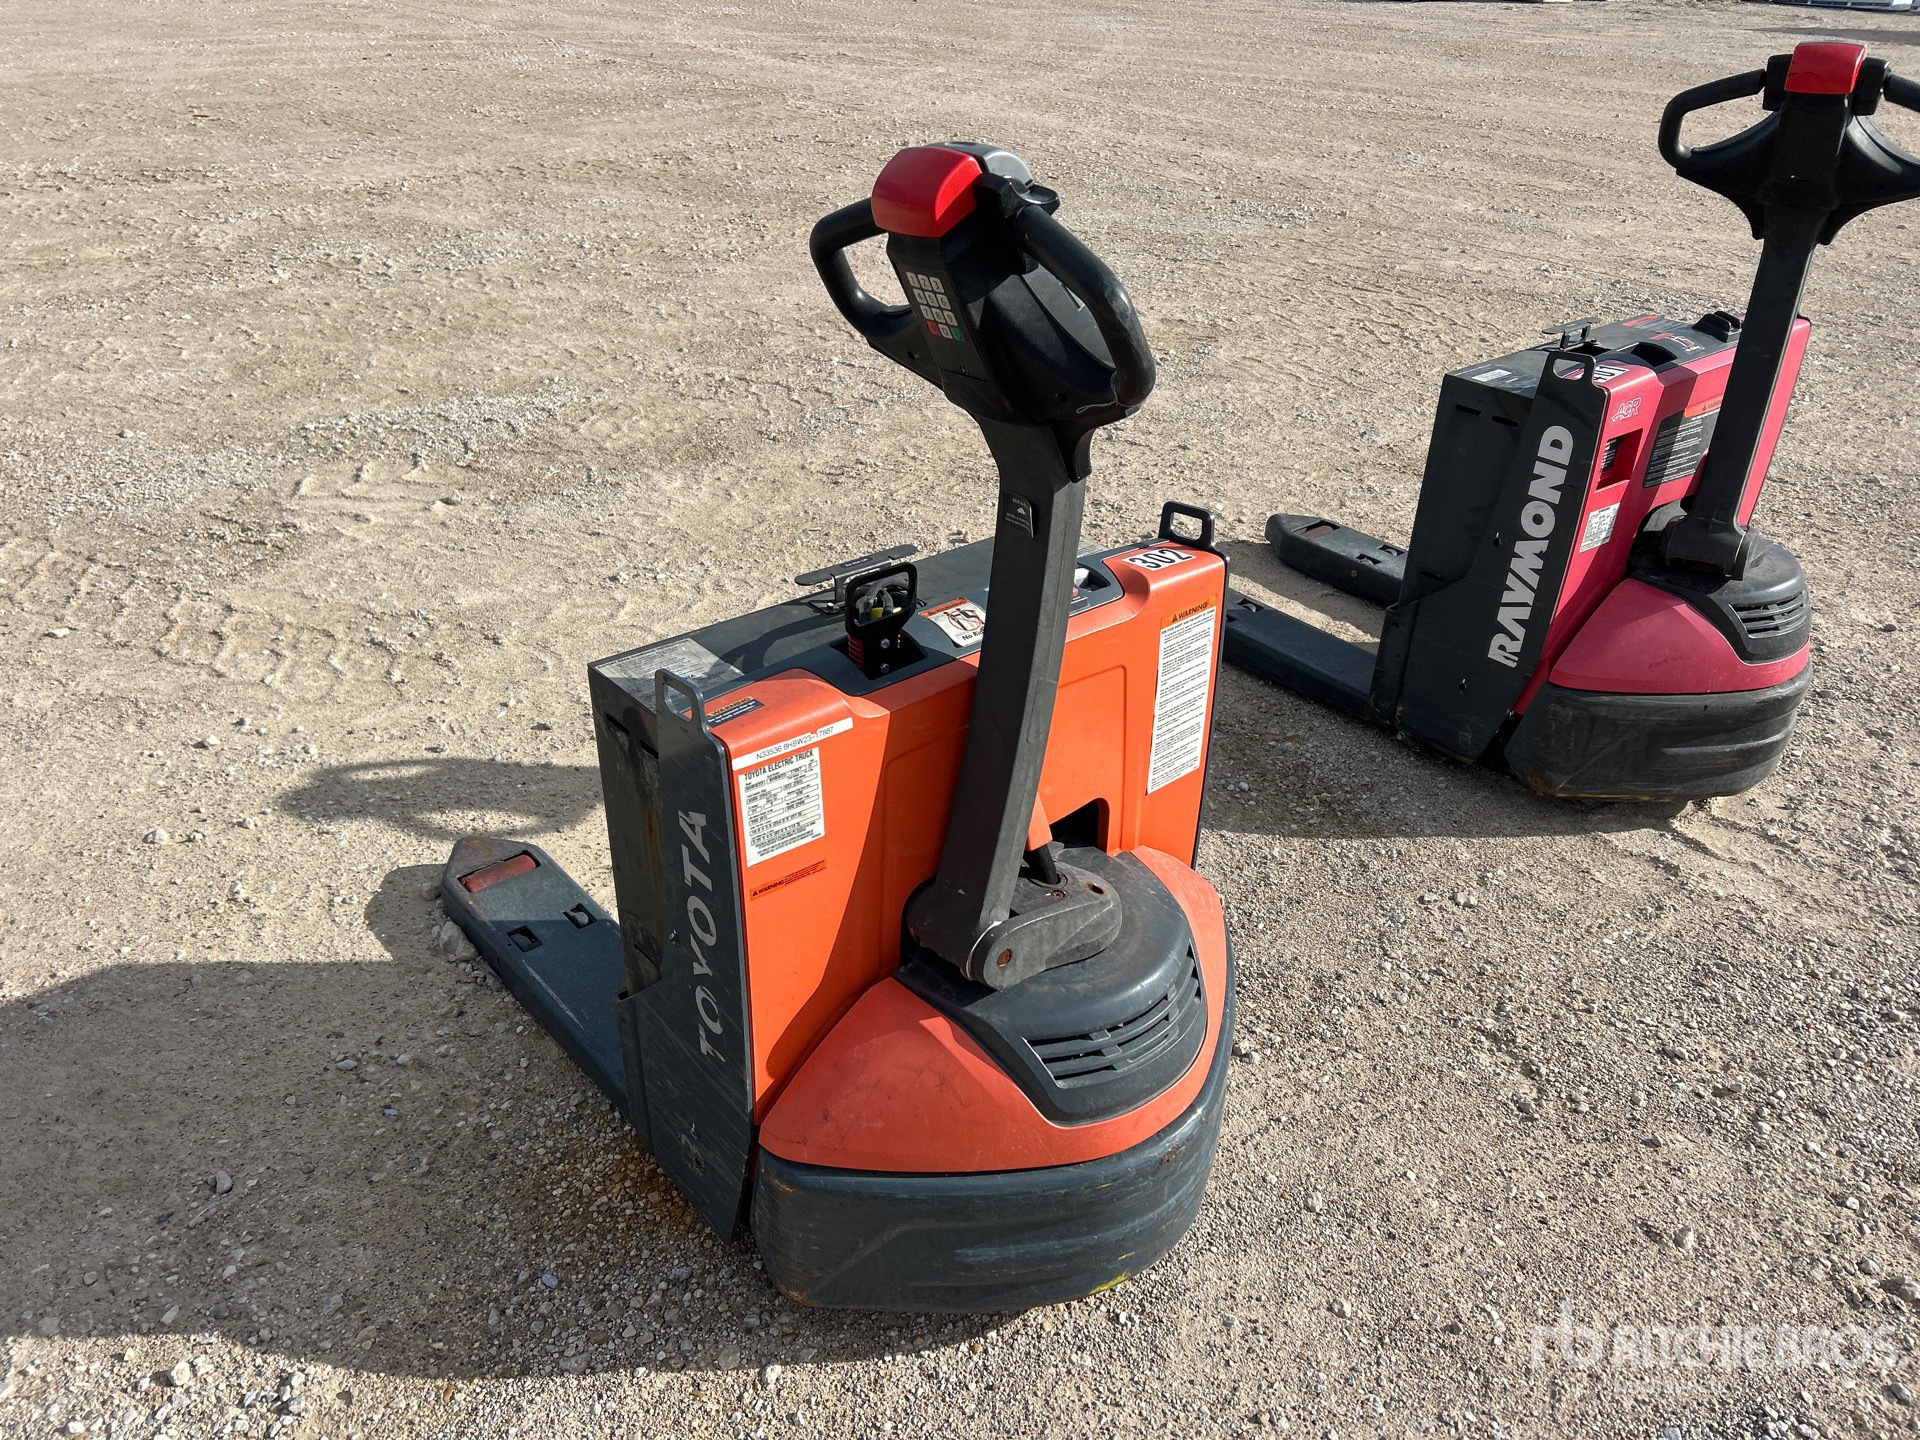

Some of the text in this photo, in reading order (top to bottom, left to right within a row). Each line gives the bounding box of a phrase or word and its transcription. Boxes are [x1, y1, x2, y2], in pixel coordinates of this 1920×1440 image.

[1487, 425, 1574, 669] RAYMOND
[1128, 548, 1193, 569] 302
[1178, 601, 1209, 620] WARNING
[711, 697, 751, 715] WARNING
[756, 745, 782, 760] N33536
[744, 766, 767, 781] TOYOTA
[768, 756, 794, 772] ELECTRIC
[795, 750, 814, 762] TRUCK
[757, 879, 784, 895] WARNING
[678, 809, 727, 1063] TOYOTA
